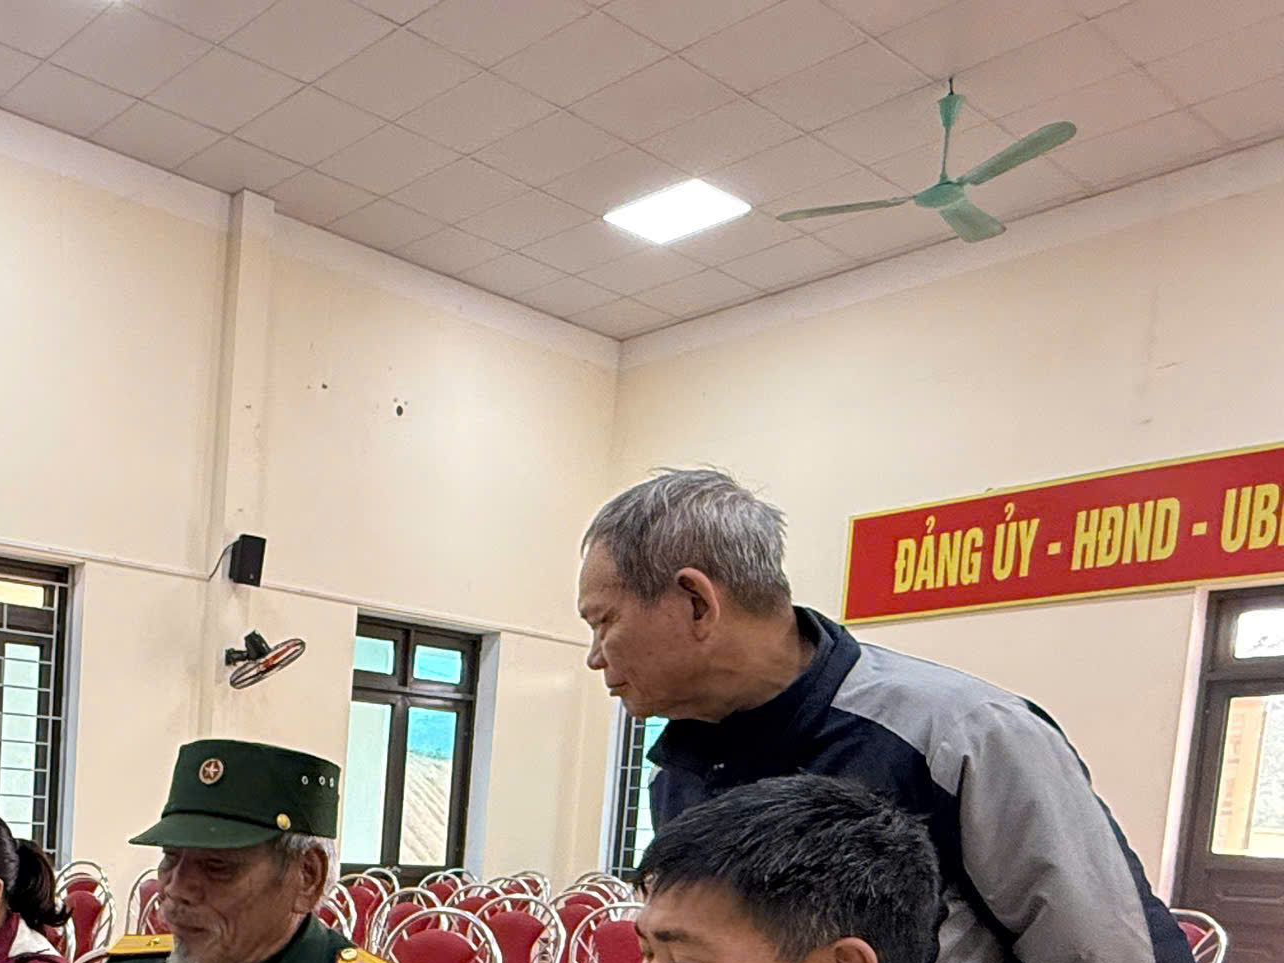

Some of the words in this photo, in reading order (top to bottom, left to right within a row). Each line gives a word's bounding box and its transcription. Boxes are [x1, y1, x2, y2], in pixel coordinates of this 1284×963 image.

[893, 516, 984, 594] ĐẢNG
[992, 502, 1041, 581] ỦY
[1047, 541, 1062, 556] -
[1071, 497, 1180, 571] HĐND
[1191, 521, 1208, 537] -
[1220, 483, 1284, 553] UB
